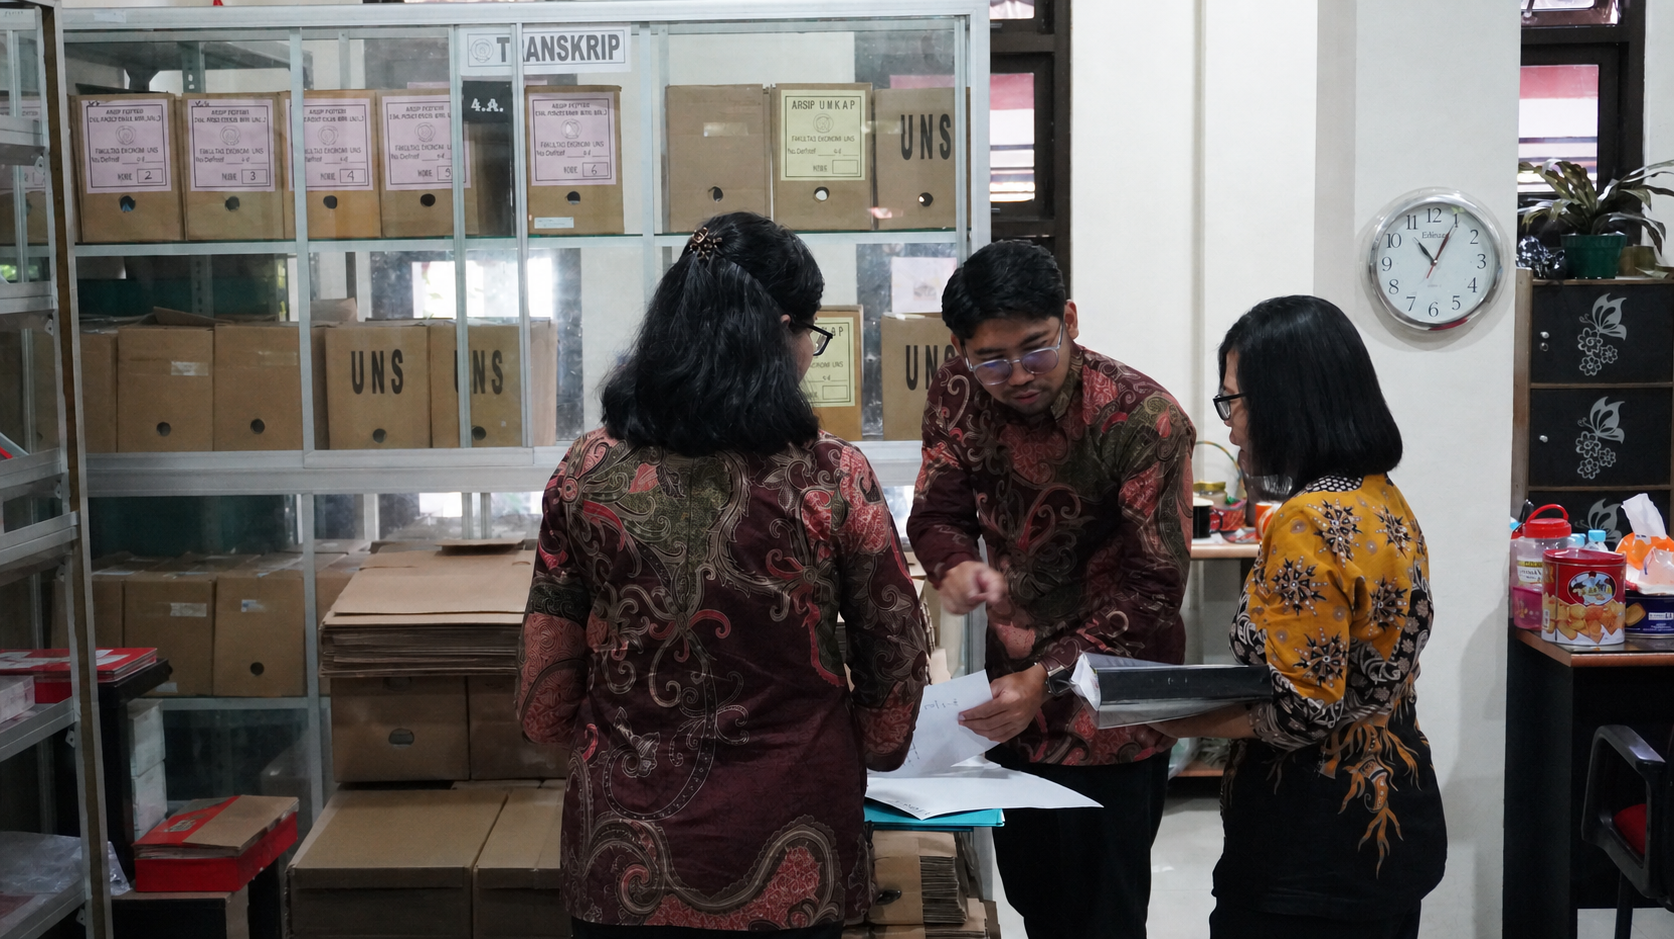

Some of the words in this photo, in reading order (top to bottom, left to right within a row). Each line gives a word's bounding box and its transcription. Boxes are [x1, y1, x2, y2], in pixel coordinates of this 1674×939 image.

[497, 34, 620, 62] TANSKRIP
[791, 100, 815, 110] ARSIP
[901, 113, 951, 160] UNS
[144, 170, 152, 180] 2
[250, 171, 256, 181] 3
[347, 170, 355, 181] 4
[591, 164, 597, 175] 6
[1406, 214, 1418, 230] 11
[1426, 207, 1442, 223] 12
[1453, 213, 1459, 228] 1
[1386, 232, 1402, 248] 10
[1469, 229, 1479, 245] 2
[1381, 256, 1392, 271] 9
[1476, 253, 1487, 269] 3
[1388, 279, 1399, 294] 8
[1467, 277, 1478, 293] 4
[1406, 296, 1416, 312] 7
[1428, 302, 1439, 317] 6
[1451, 295, 1461, 310] 5
[351, 348, 404, 395] UNS
